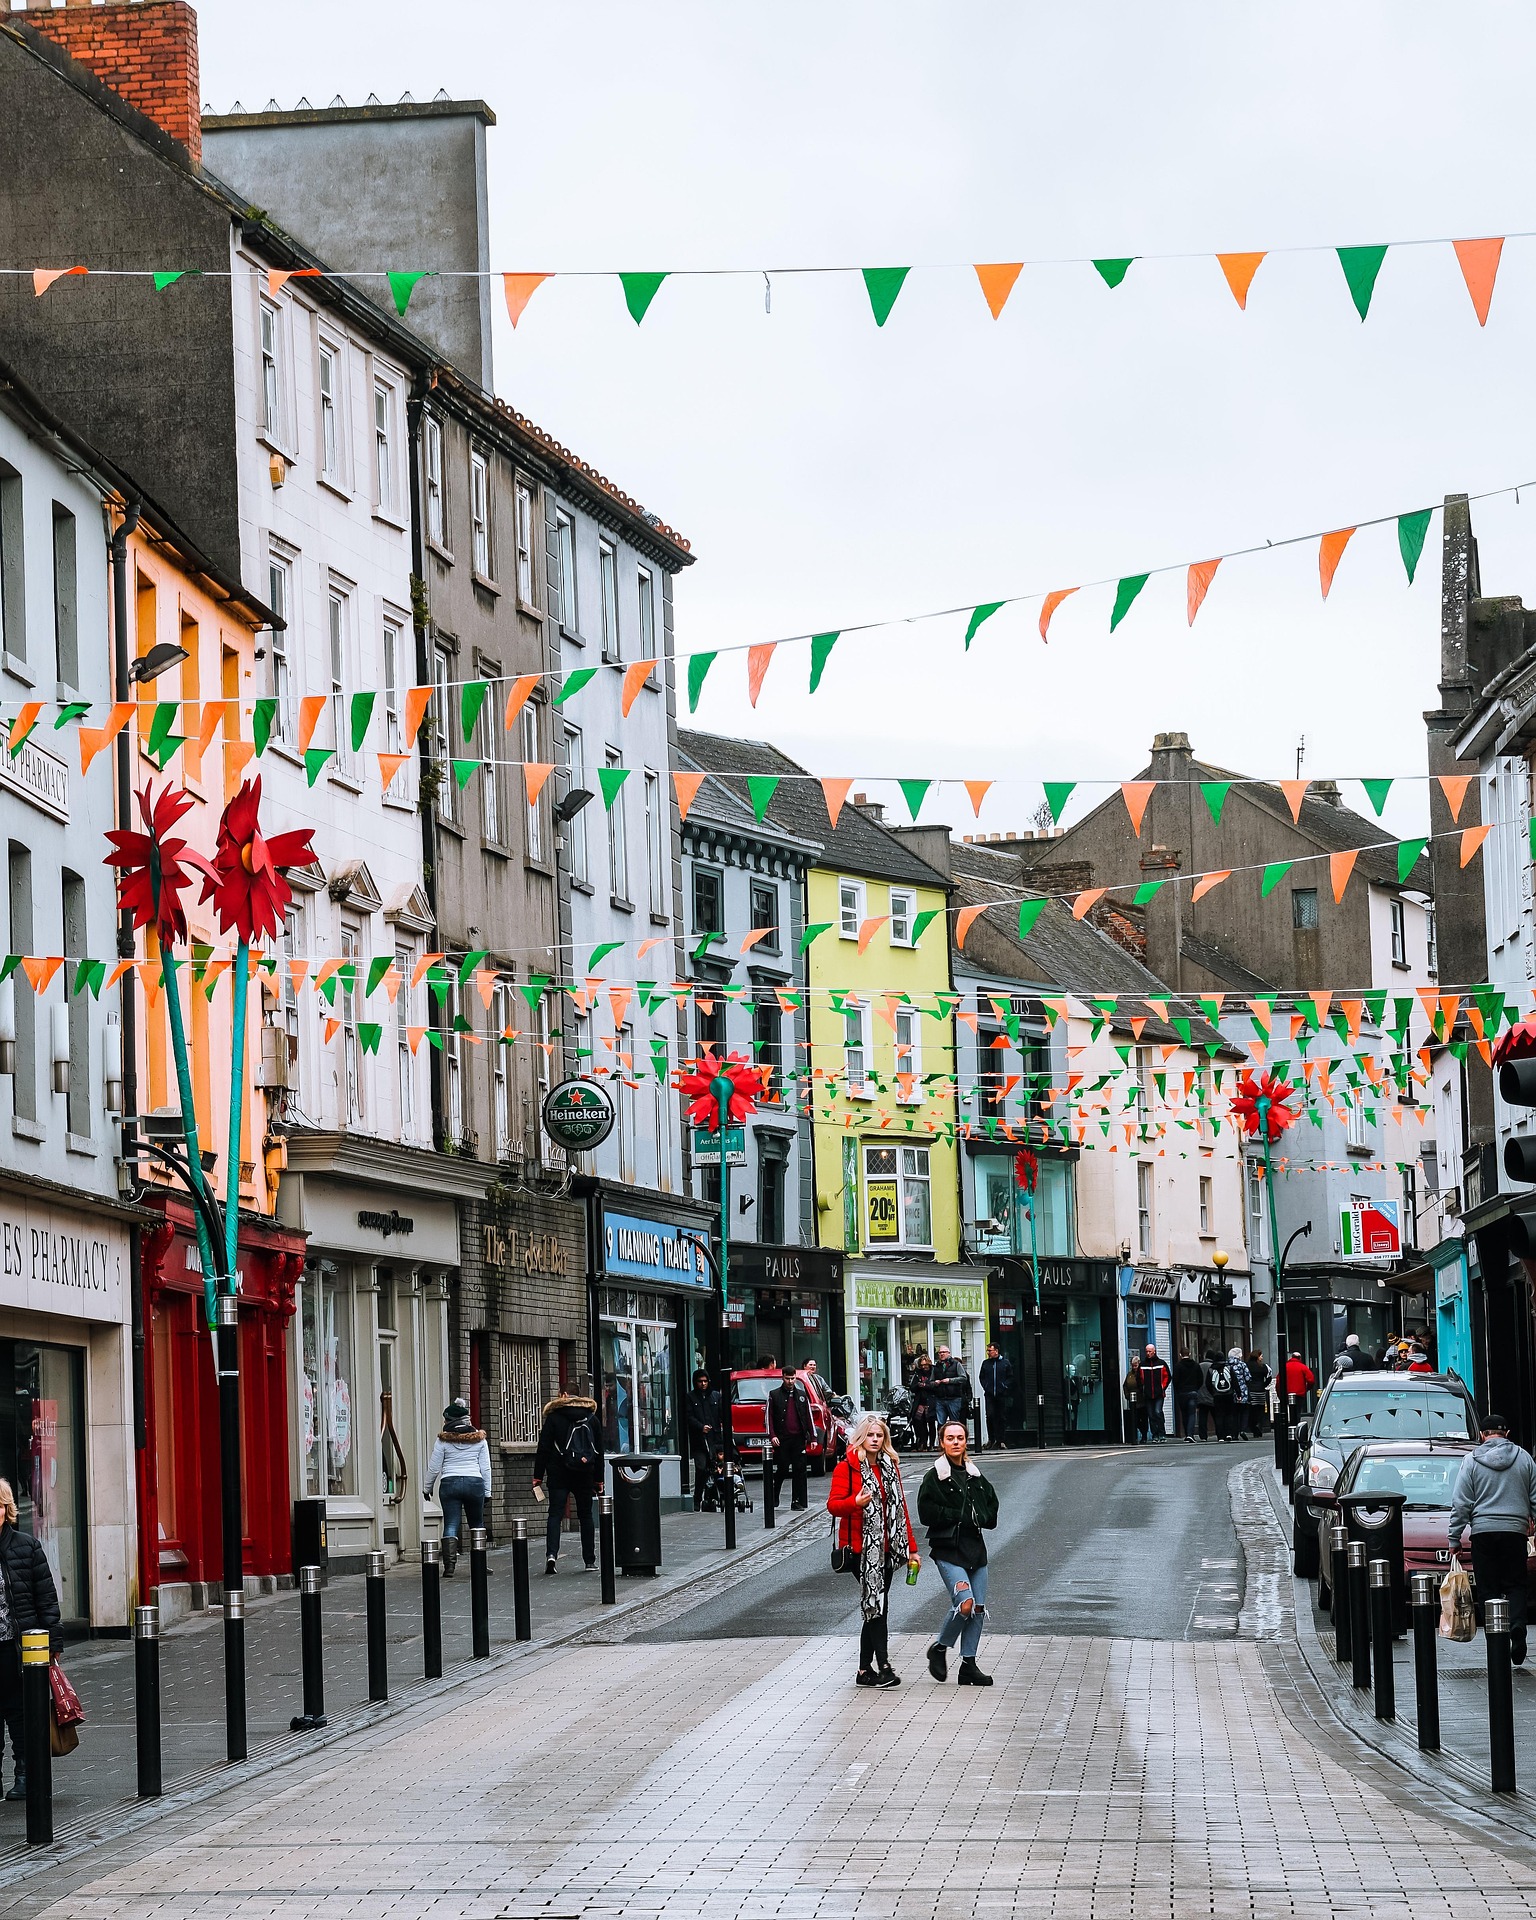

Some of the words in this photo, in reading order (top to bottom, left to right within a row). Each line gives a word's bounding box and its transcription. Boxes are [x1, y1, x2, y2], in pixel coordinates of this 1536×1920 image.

[20, 748, 66, 805] PHARMACY
[550, 1108, 606, 1120] Heineken
[870, 1197, 895, 1221] 20%
[1352, 1202, 1364, 1210] TO
[1351, 1211, 1361, 1254] FitzGerald
[0, 1222, 21, 1277] ES
[31, 1228, 108, 1292] PHARMACY
[483, 1225, 506, 1266] The
[549, 1236, 569, 1276] Bar
[606, 1226, 614, 1258] 9
[619, 1227, 660, 1266] MANNING
[662, 1236, 692, 1271] TRAVEL
[765, 1256, 801, 1279] PAULS
[831, 1264, 838, 1278] 12
[1036, 1265, 1072, 1286] PAULS
[1101, 1271, 1109, 1284] 14
[893, 1285, 948, 1309] GRAHAMS
